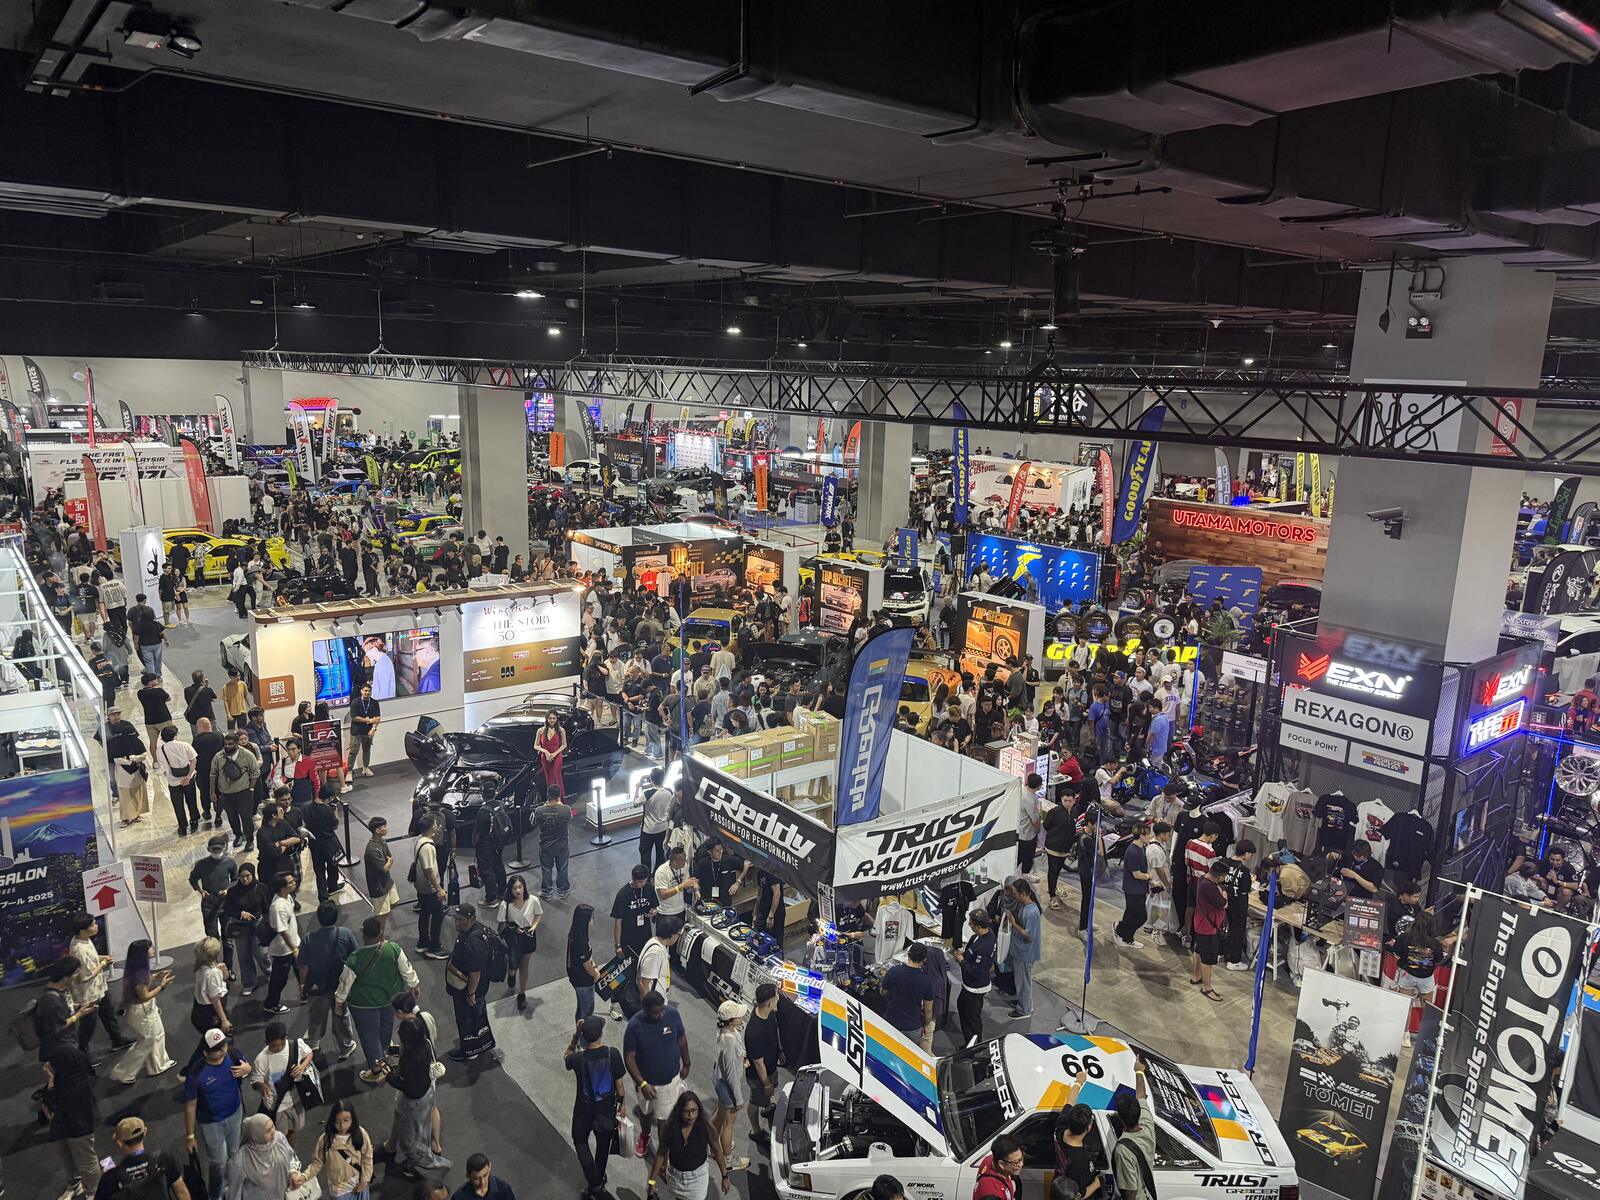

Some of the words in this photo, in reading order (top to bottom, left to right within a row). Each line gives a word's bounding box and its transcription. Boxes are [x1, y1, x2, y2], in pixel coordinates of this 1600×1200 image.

[1173, 509, 1234, 532] UTAMA
[1236, 517, 1317, 544] MOTORS
[1326, 662, 1406, 693] EXN
[1497, 668, 1530, 692] EXN
[308, 730, 338, 742] LFA
[1294, 698, 1414, 741] REXAGON®
[1288, 732, 1313, 745] FOCUS
[1315, 740, 1338, 752] POINT
[609, 804, 635, 815] Powere
[866, 789, 1006, 855] TRUST
[710, 810, 736, 833] PASSION
[737, 827, 750, 841] FOR
[752, 835, 800, 871] PERFORMANCE
[852, 839, 957, 879] RACING
[880, 857, 972, 892] www.trust-power.co
[28, 891, 54, 902] 2025
[1494, 910, 1519, 957] The
[1475, 958, 1506, 1046] Engine
[846, 999, 866, 1090] TRUST
[1061, 1053, 1105, 1079] 66
[1336, 1085, 1381, 1105] ENGINEERING
[1339, 1082, 1360, 1093] RACE
[1360, 1090, 1377, 1098] CAR
[1451, 1045, 1489, 1169] Specialist
[1473, 996, 1561, 1195] TOMEI
[1194, 1174, 1279, 1187] TRUST
